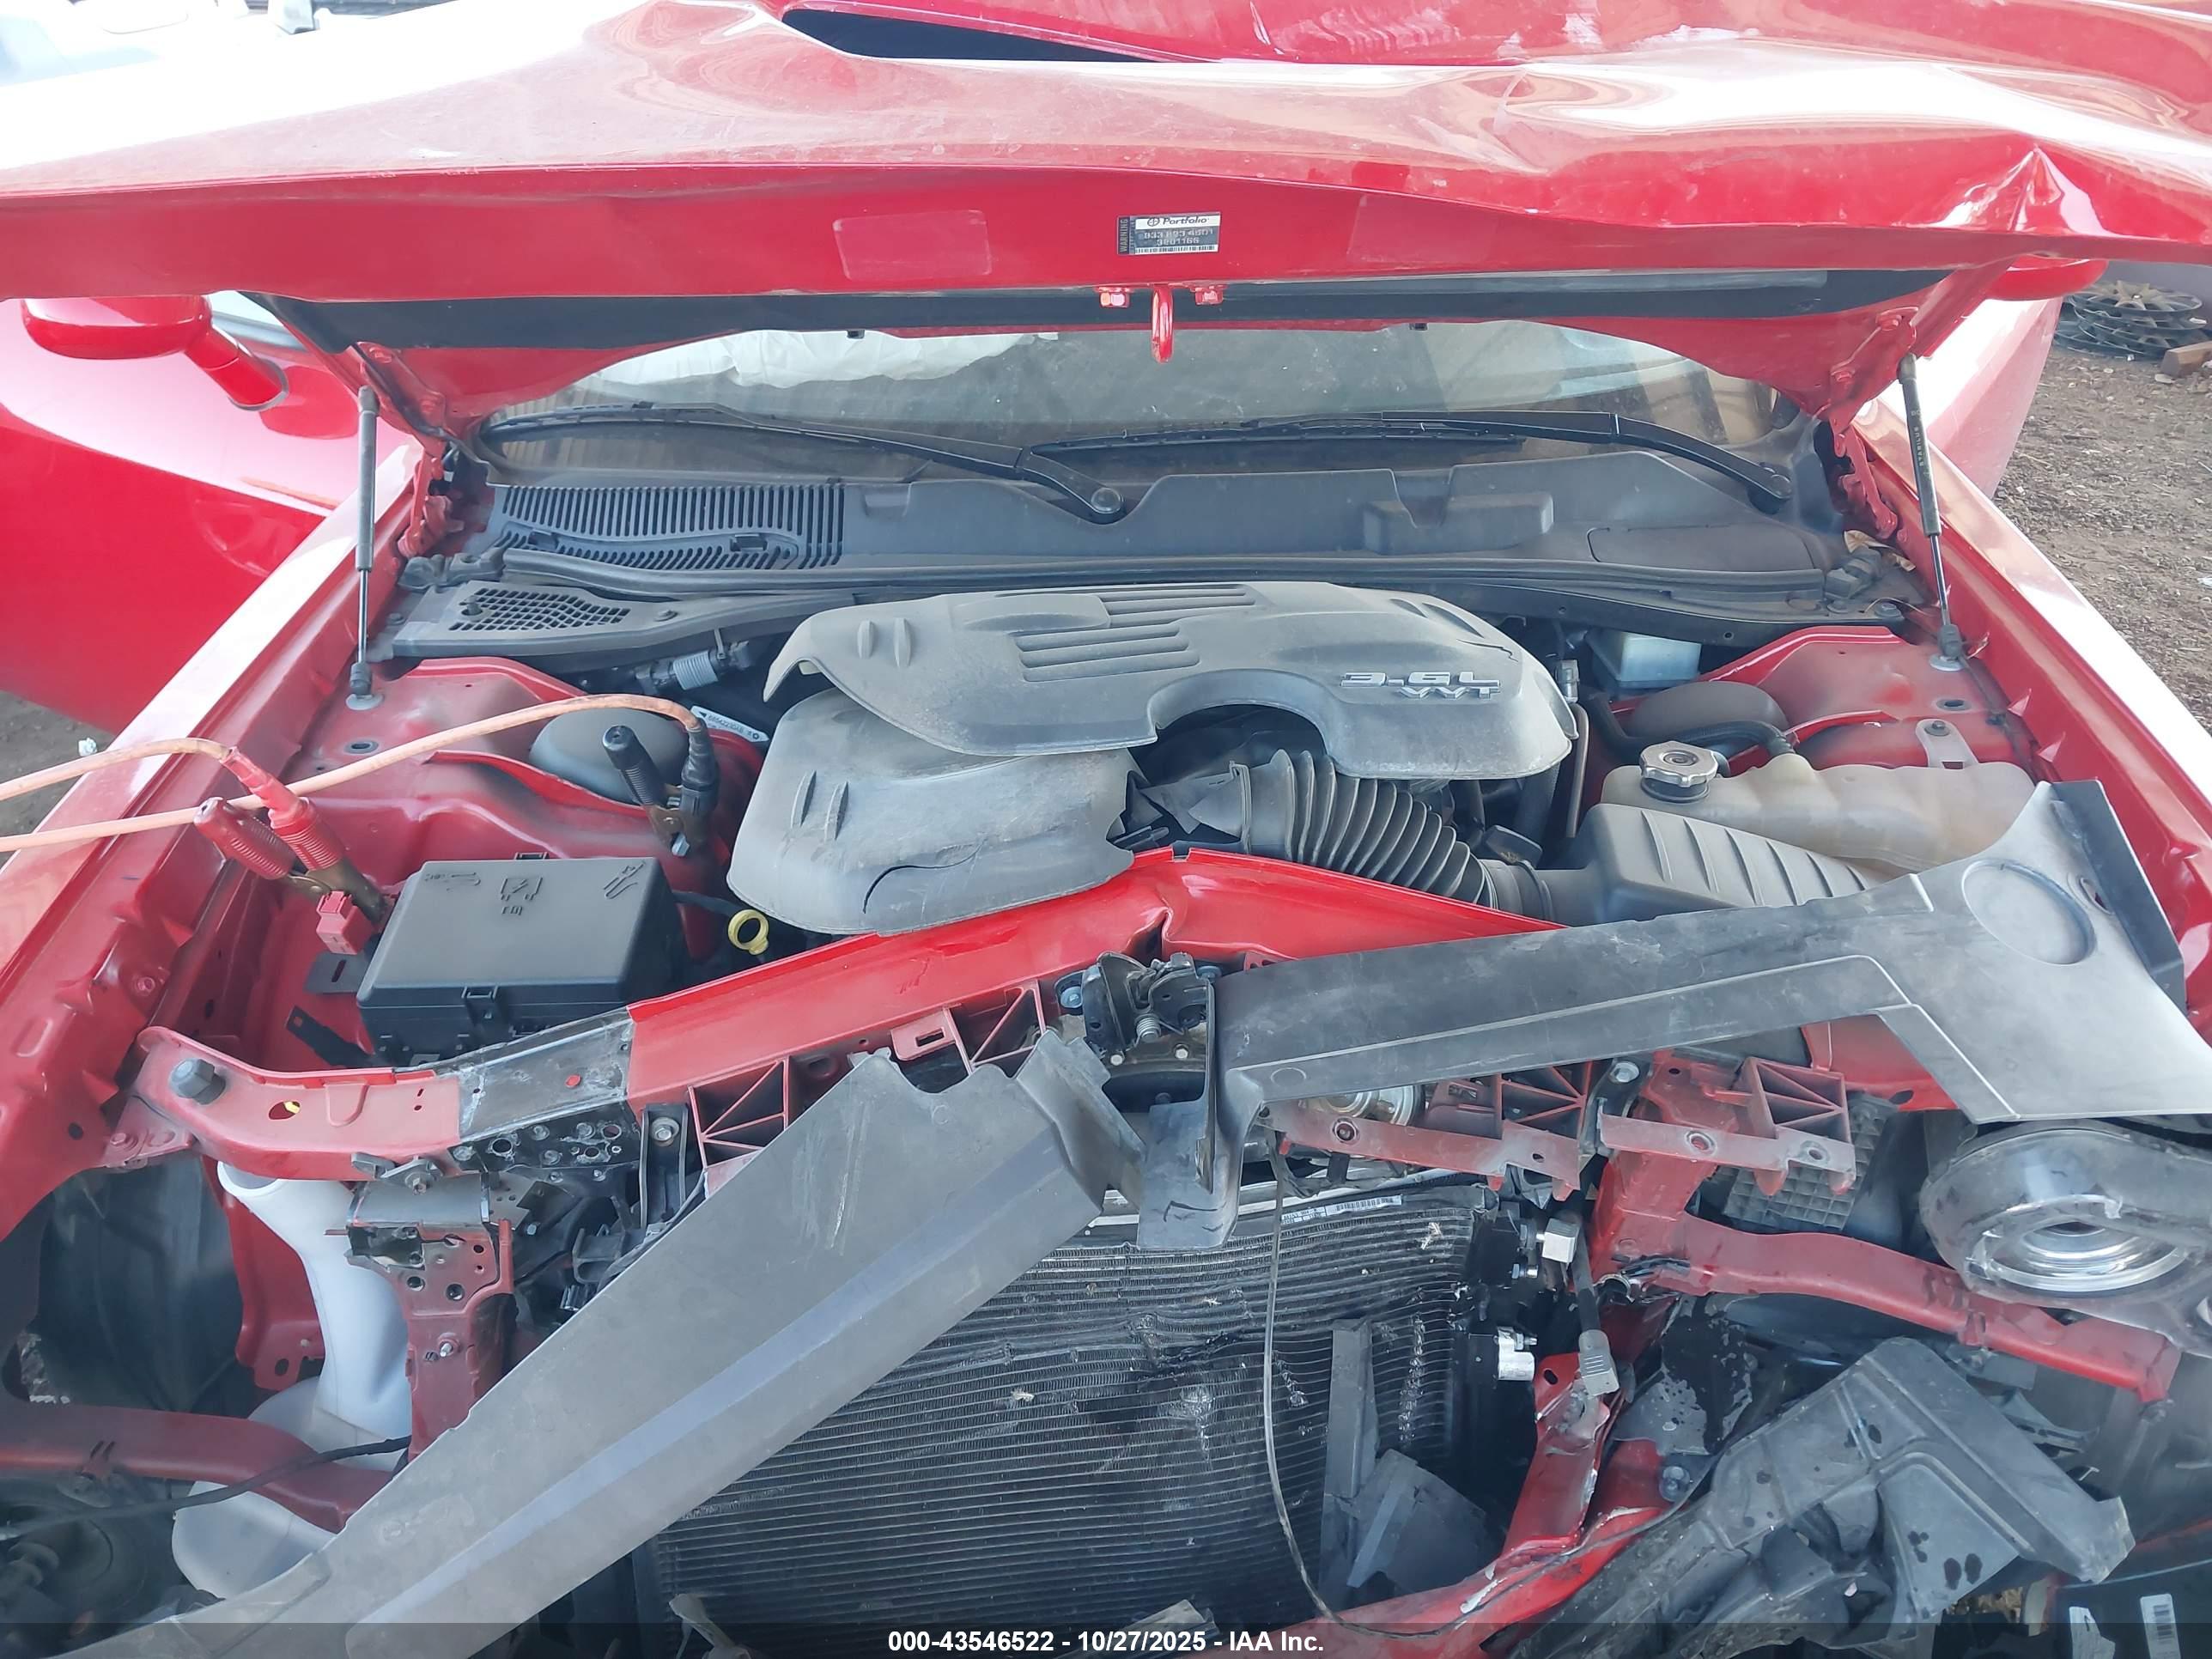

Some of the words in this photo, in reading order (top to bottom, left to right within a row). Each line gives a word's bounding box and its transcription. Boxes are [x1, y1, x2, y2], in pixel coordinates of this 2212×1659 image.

[1163, 216, 1207, 225] Portfolio
[1120, 219, 1128, 252] WARNING
[1340, 671, 1501, 688] 3.6L
[1395, 686, 1501, 700] VVT
